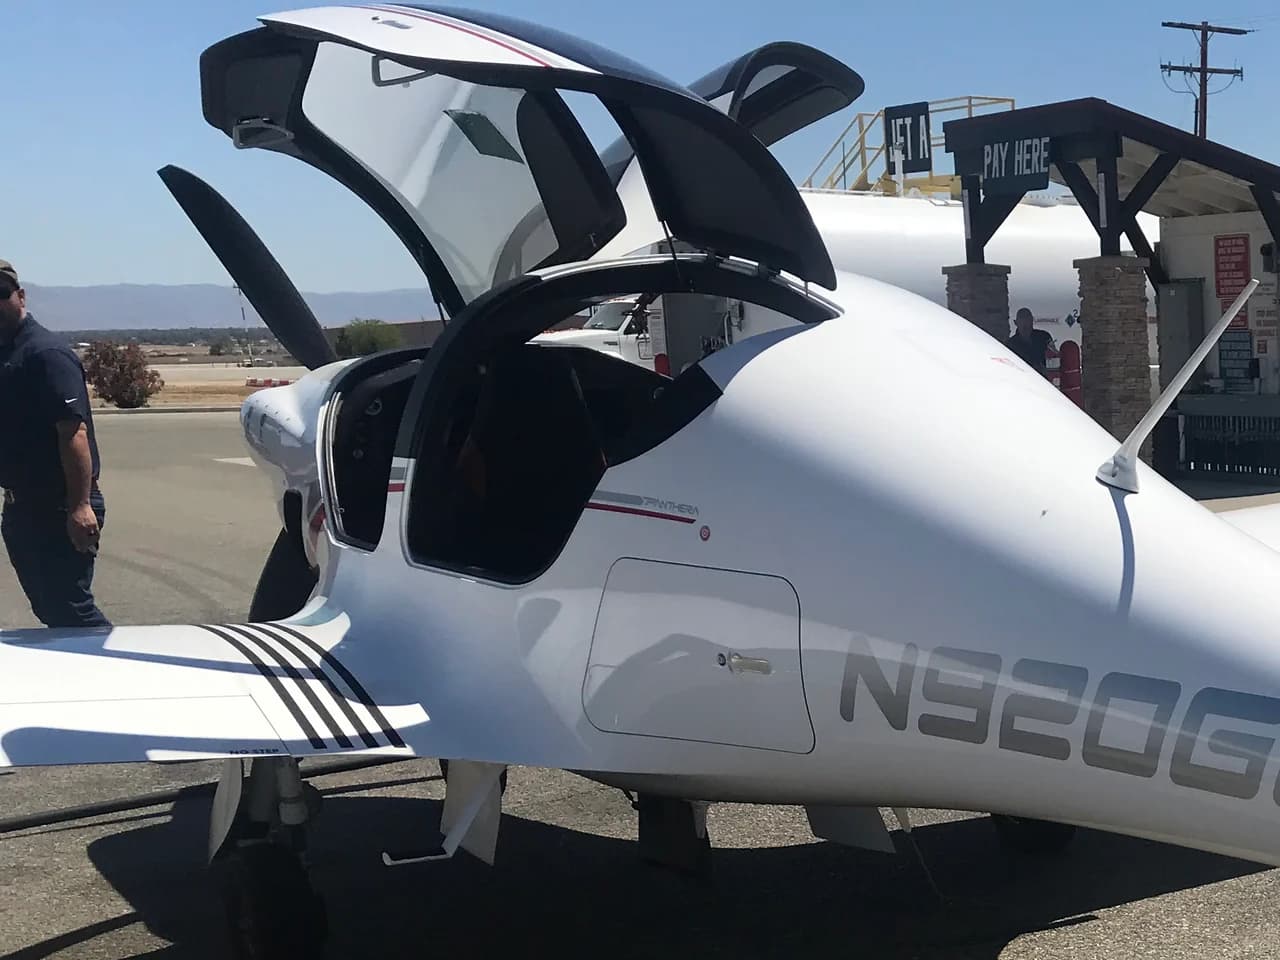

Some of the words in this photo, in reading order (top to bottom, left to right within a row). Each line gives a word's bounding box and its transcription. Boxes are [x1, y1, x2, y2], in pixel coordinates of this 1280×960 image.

[889, 117, 912, 163] JET
[919, 114, 929, 159] A
[983, 141, 1009, 179] PAY
[1014, 136, 1050, 176] HERE
[642, 496, 699, 516] PANTHERA
